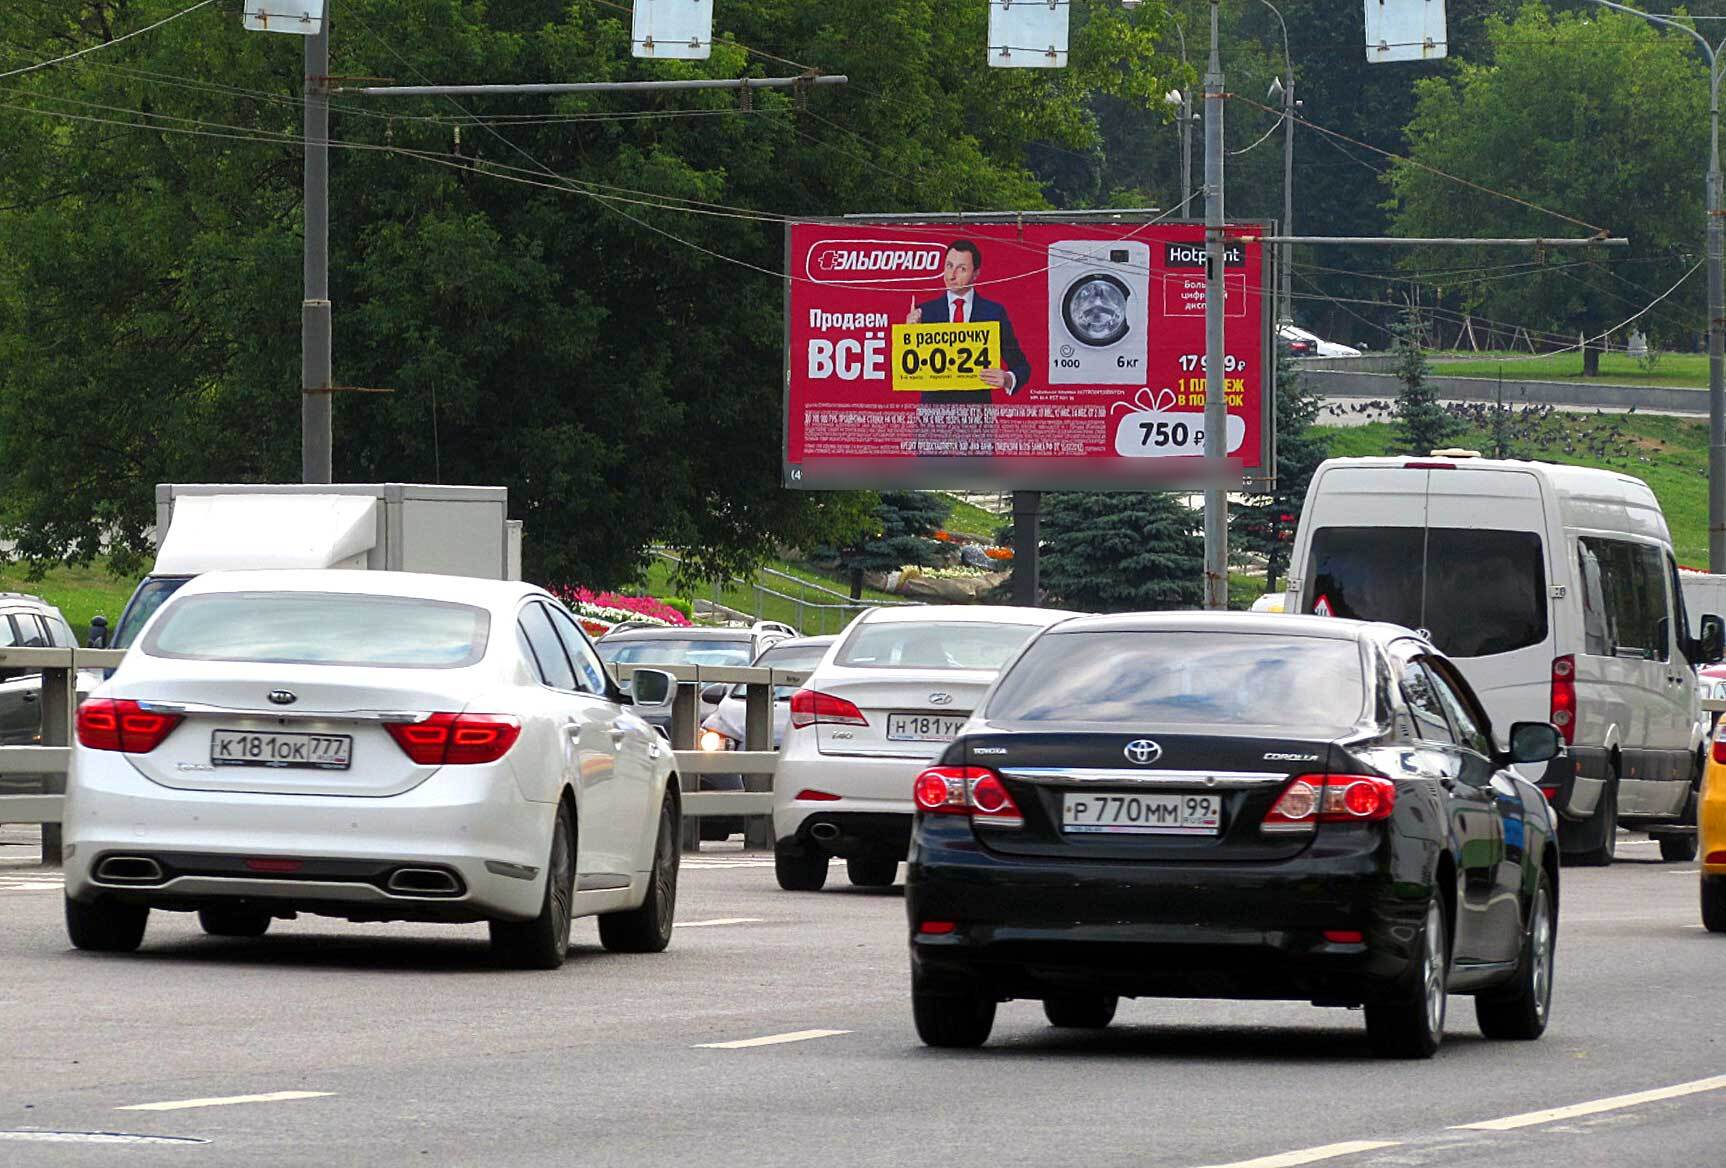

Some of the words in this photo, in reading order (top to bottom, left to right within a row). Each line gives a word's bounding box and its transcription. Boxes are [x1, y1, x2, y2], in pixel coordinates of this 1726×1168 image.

[1170, 248, 1240, 265] Hotpnt
[809, 308, 888, 331] Продаем
[903, 333, 911, 345] в
[916, 330, 990, 347] рассрочку
[808, 331, 886, 380] ВСЁ
[1178, 378, 1185, 392] 1
[1190, 378, 1245, 392] ПЛЕЖ
[1189, 394, 1244, 406] ПОРОК
[1139, 422, 1189, 447] 750
[1263, 752, 1319, 761] COROLLA
[1186, 798, 1211, 816] 99
